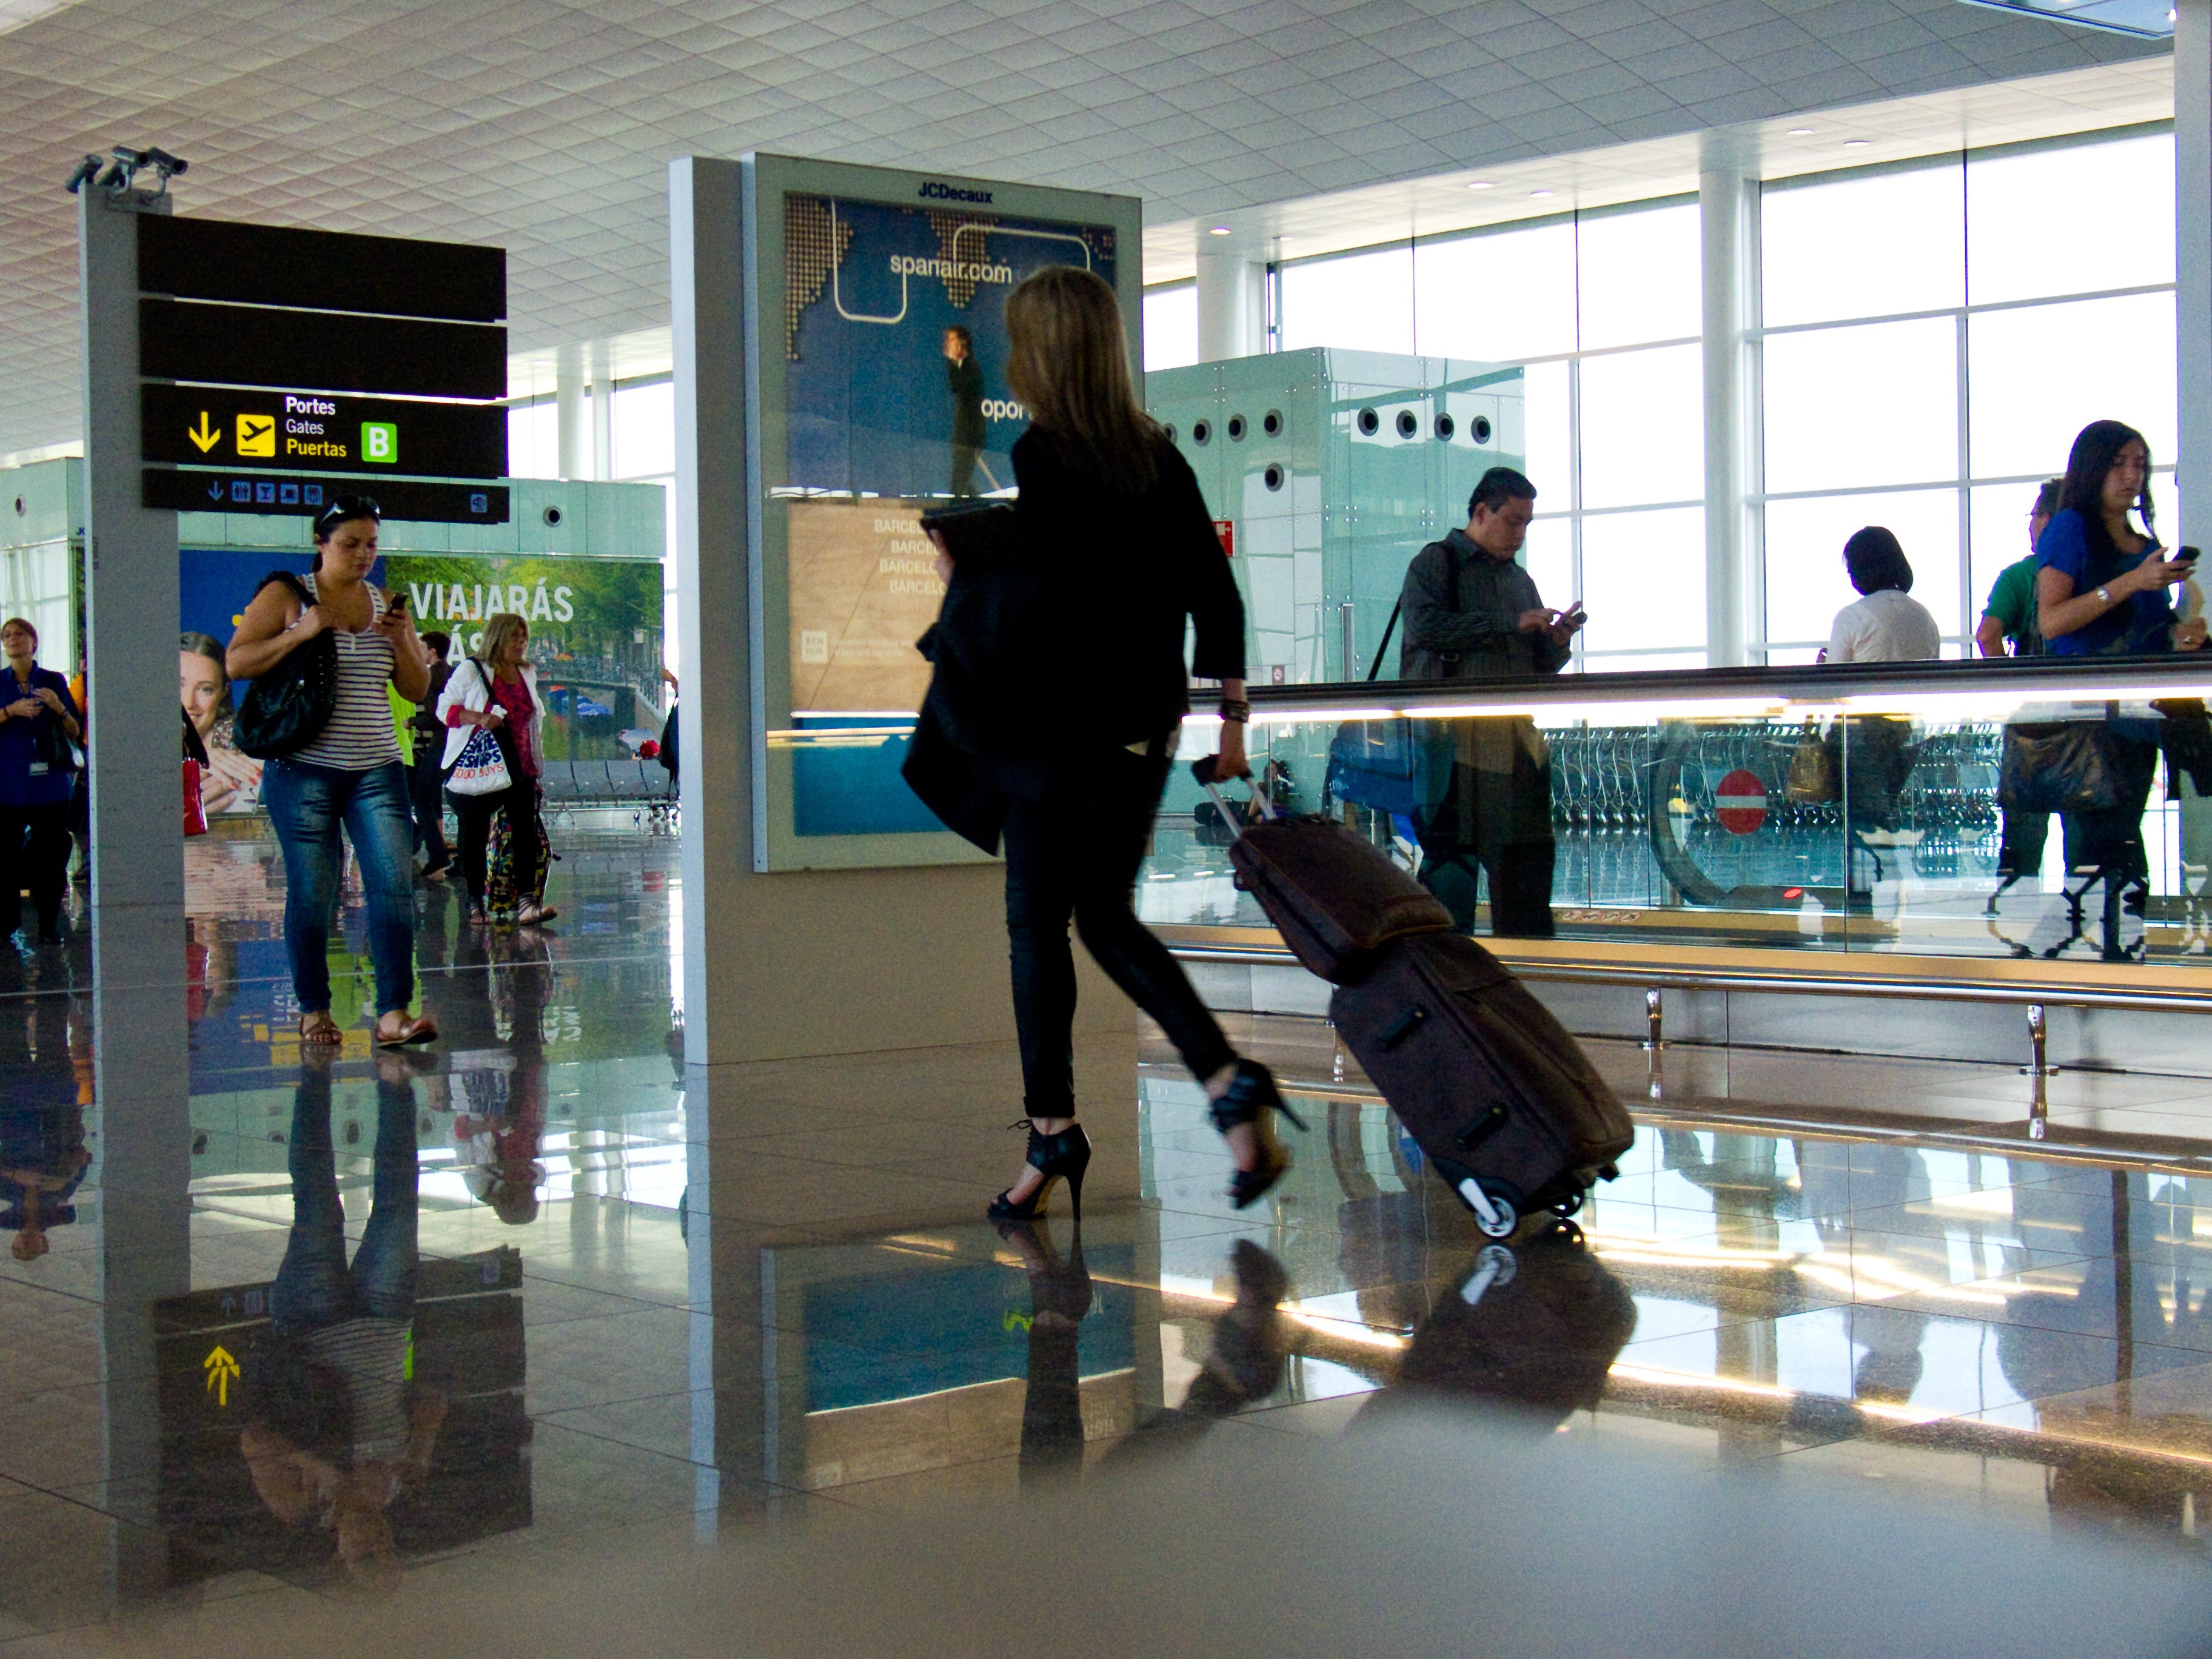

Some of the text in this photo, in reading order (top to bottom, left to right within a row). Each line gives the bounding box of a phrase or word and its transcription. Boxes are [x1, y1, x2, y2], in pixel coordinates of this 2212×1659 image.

[918, 181, 993, 204] JCDecaux
[890, 253, 1012, 284] spanair.com
[286, 396, 336, 416] Portes
[286, 418, 324, 435] Gates
[286, 438, 347, 458] Puertas
[369, 426, 389, 457] B
[409, 577, 574, 623] VIAJARÁS
